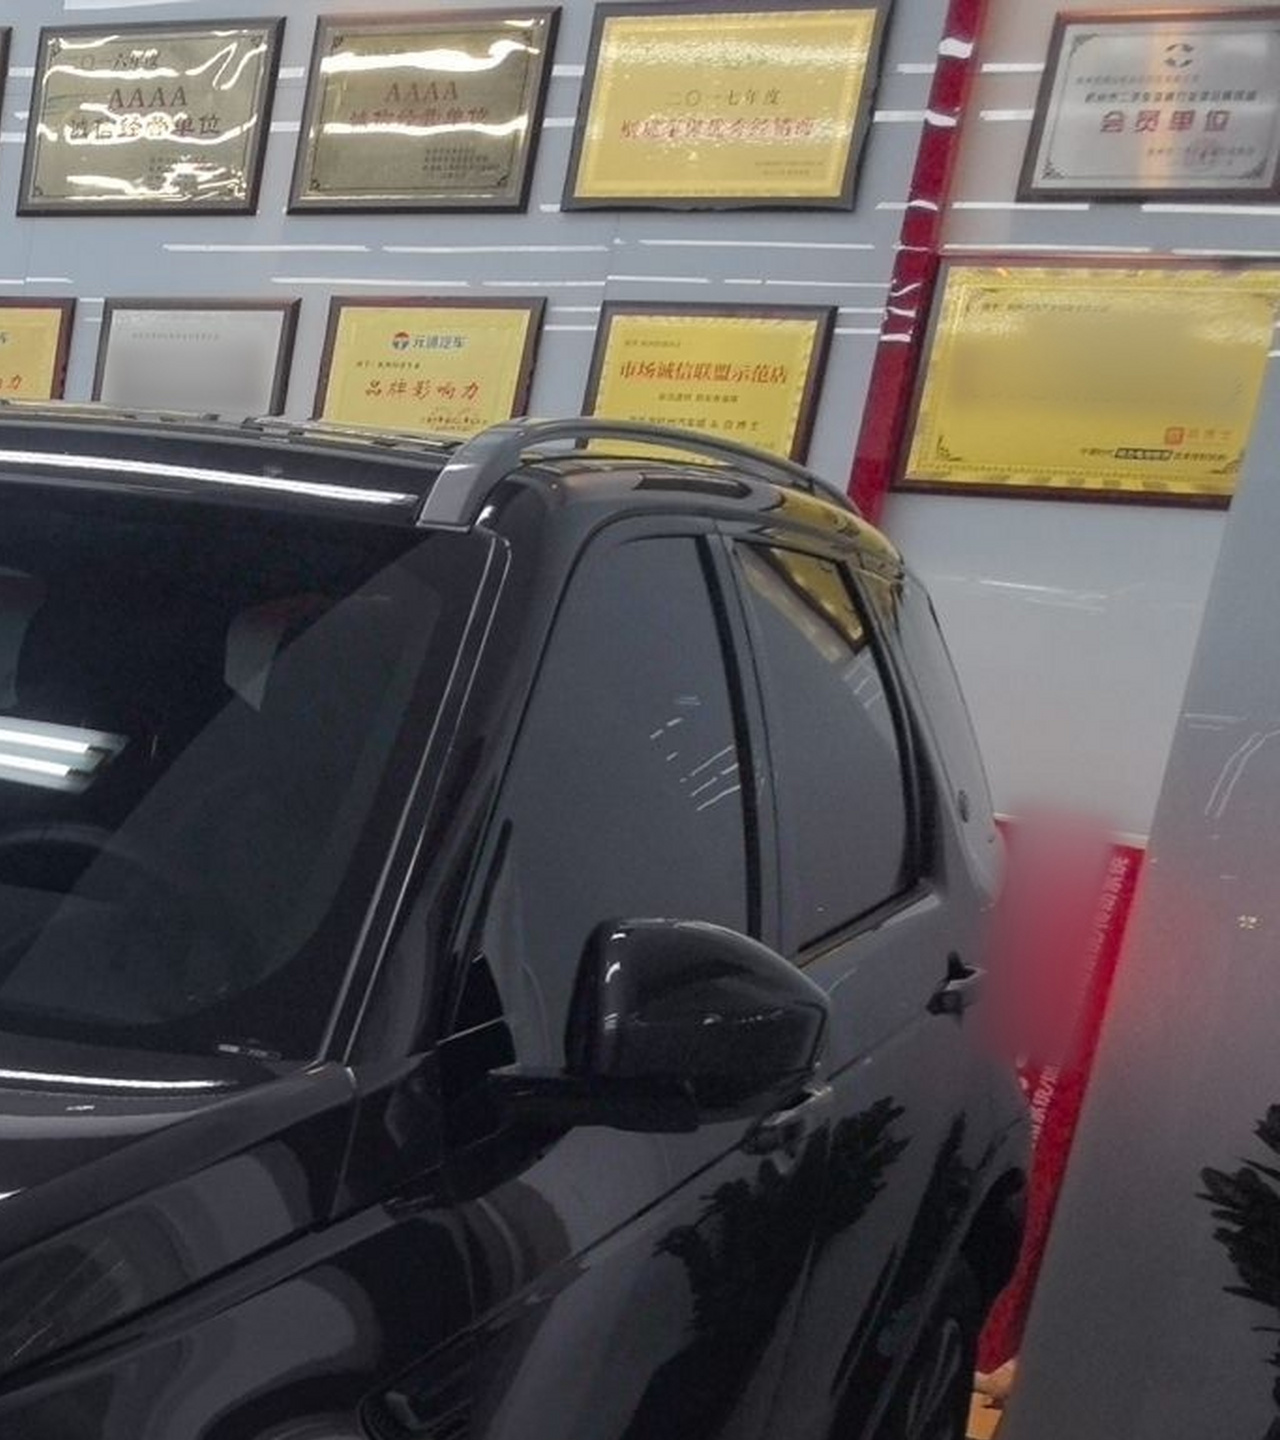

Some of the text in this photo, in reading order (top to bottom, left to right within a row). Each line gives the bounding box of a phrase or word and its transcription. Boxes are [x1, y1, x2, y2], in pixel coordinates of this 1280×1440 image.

[108, 85, 188, 109] AAAA
[385, 80, 459, 102] AAAA
[1099, 109, 1231, 134] 会员单位
[619, 360, 788, 384] 市场诚信联盟示范店
[365, 379, 480, 400] 品牌影响力
